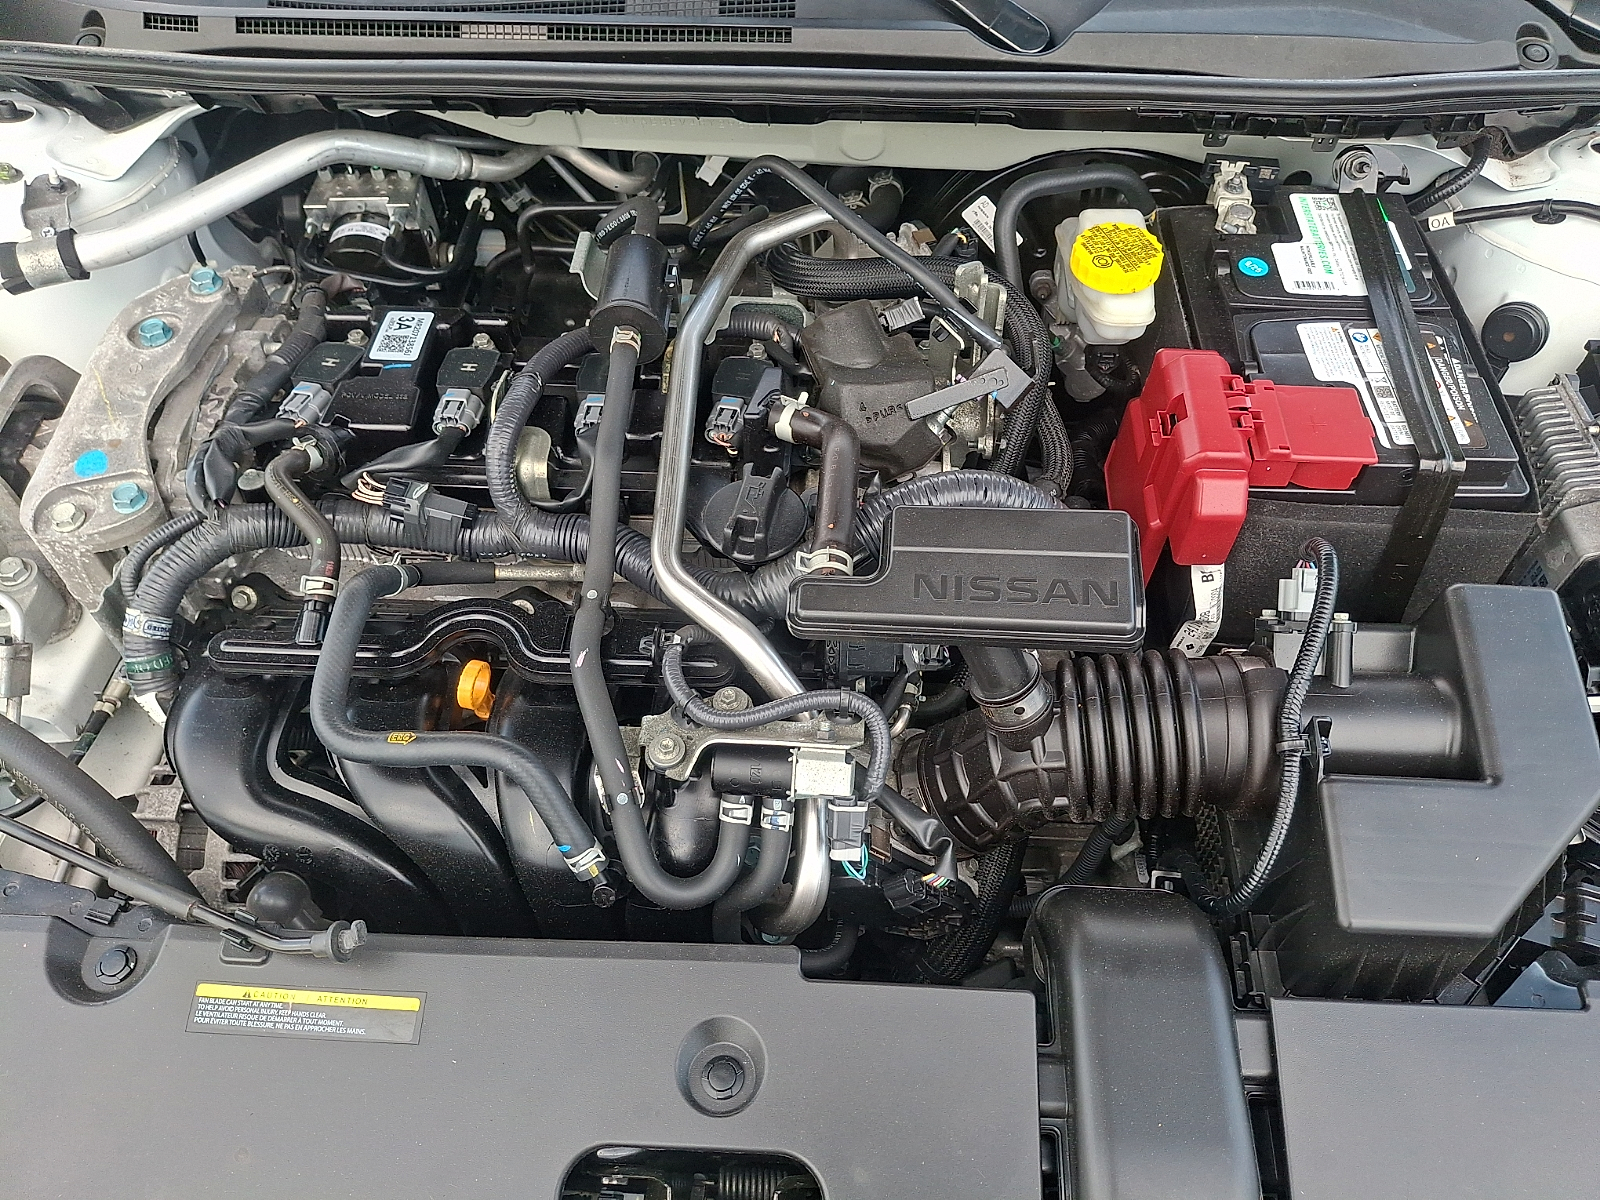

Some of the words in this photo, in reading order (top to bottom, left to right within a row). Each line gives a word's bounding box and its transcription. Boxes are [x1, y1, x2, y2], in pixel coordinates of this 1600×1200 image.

[1298, 196, 1334, 275] INTERSTATEBATTERIES.COM
[393, 315, 416, 331] 3A
[1434, 357, 1466, 411] DANGER/POISON
[913, 573, 1120, 608] NISSAN
[391, 732, 410, 741] ENG
[253, 990, 296, 1000] CAUTION
[317, 995, 369, 1005] ATTENTION
[235, 1006, 260, 1014] PERSONAL
[203, 1011, 238, 1020] VENTILATEUR
[318, 1019, 344, 1027] MOMENT.
[229, 1019, 247, 1027] TOUTE
[247, 1021, 275, 1029] BLESSURE,
[303, 1024, 336, 1033] APPROCHER
